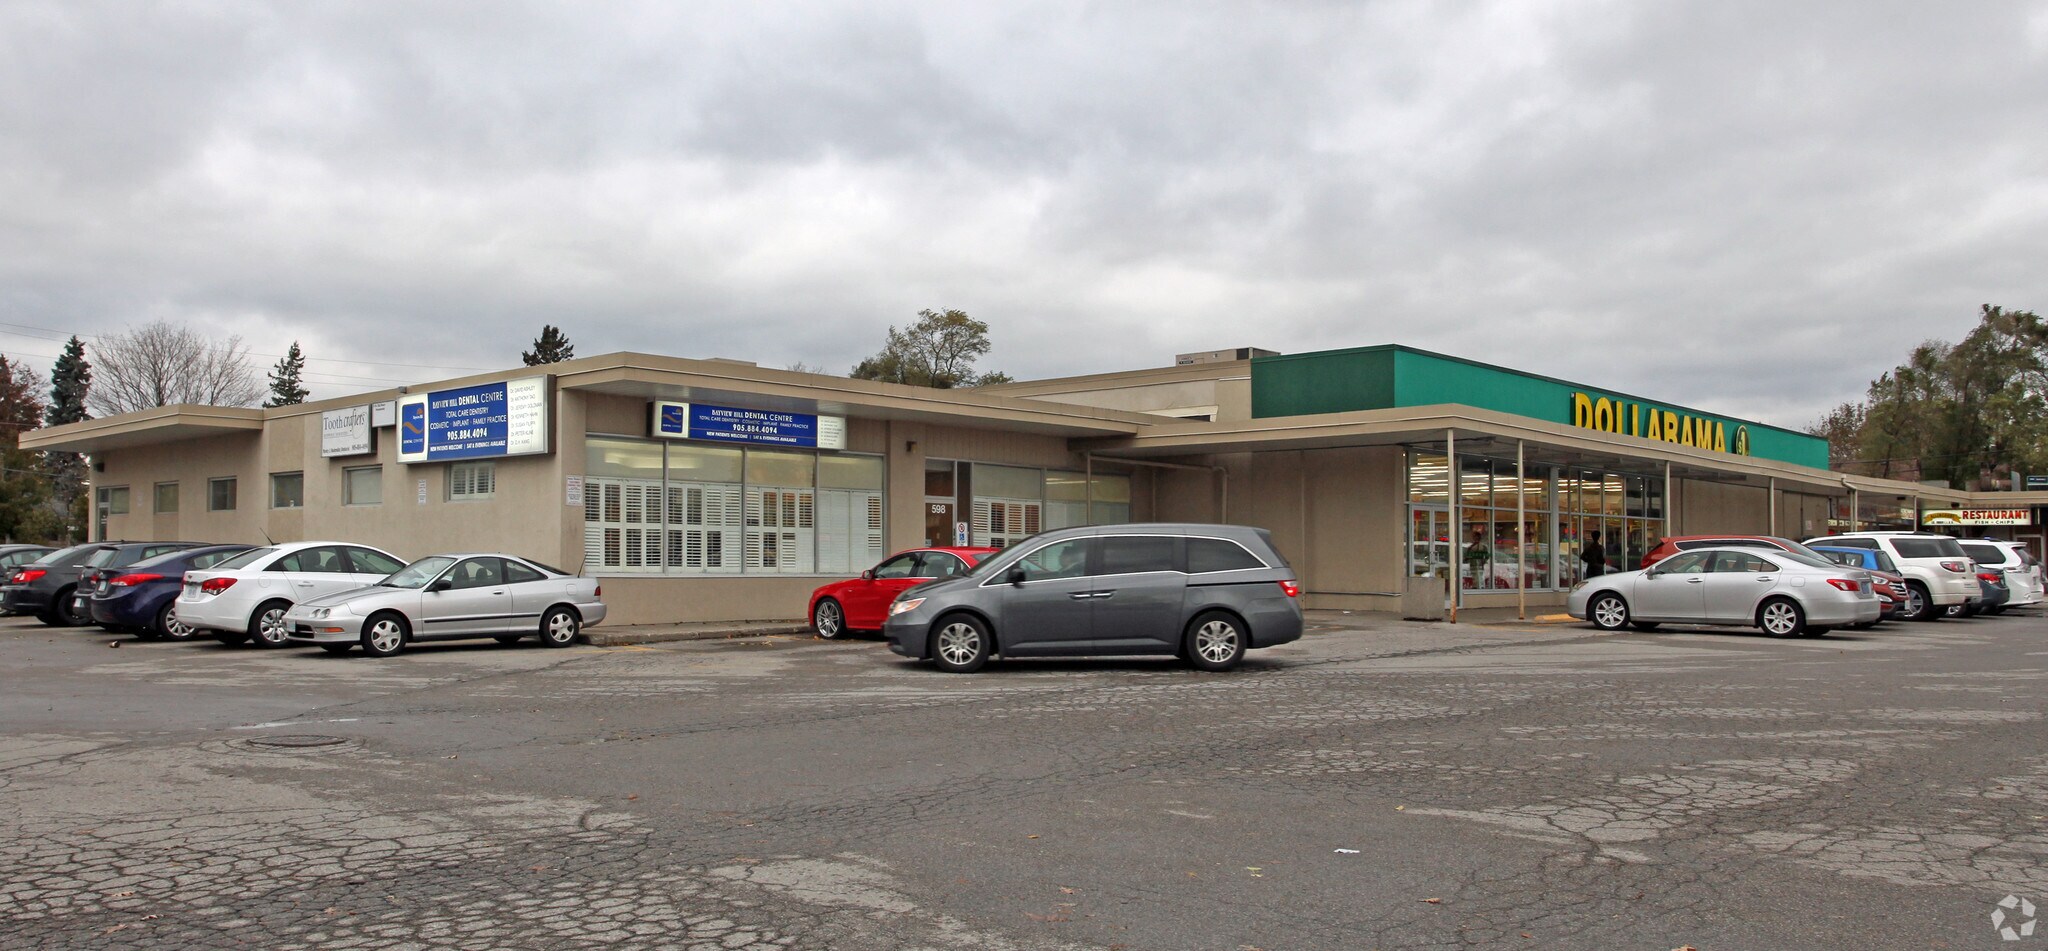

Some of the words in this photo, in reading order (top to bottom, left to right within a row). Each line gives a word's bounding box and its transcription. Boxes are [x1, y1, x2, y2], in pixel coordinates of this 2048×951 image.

[432, 400, 448, 409] BAYVIEW
[449, 399, 457, 407] HILL
[458, 394, 480, 406] DENTAL
[480, 391, 503, 403] CENTRE
[445, 411, 457, 419] TOTAL
[458, 409, 469, 417] CARE
[469, 407, 489, 416] DENTISTRY
[711, 409, 732, 417] BAYVIEW
[744, 411, 767, 420] DENTAL
[769, 413, 793, 422] CENTRE
[324, 416, 343, 430] Tooth
[430, 421, 450, 430] COSMETIC
[453, 418, 470, 427] IMPLANT
[472, 417, 486, 425] FAMILY
[487, 414, 507, 424] PRACTICE
[447, 428, 487, 440] 905.884.4094
[732, 424, 777, 434] 905.884.4094
[932, 505, 945, 513] 598
[1962, 510, 2029, 520] RESTAURANT
